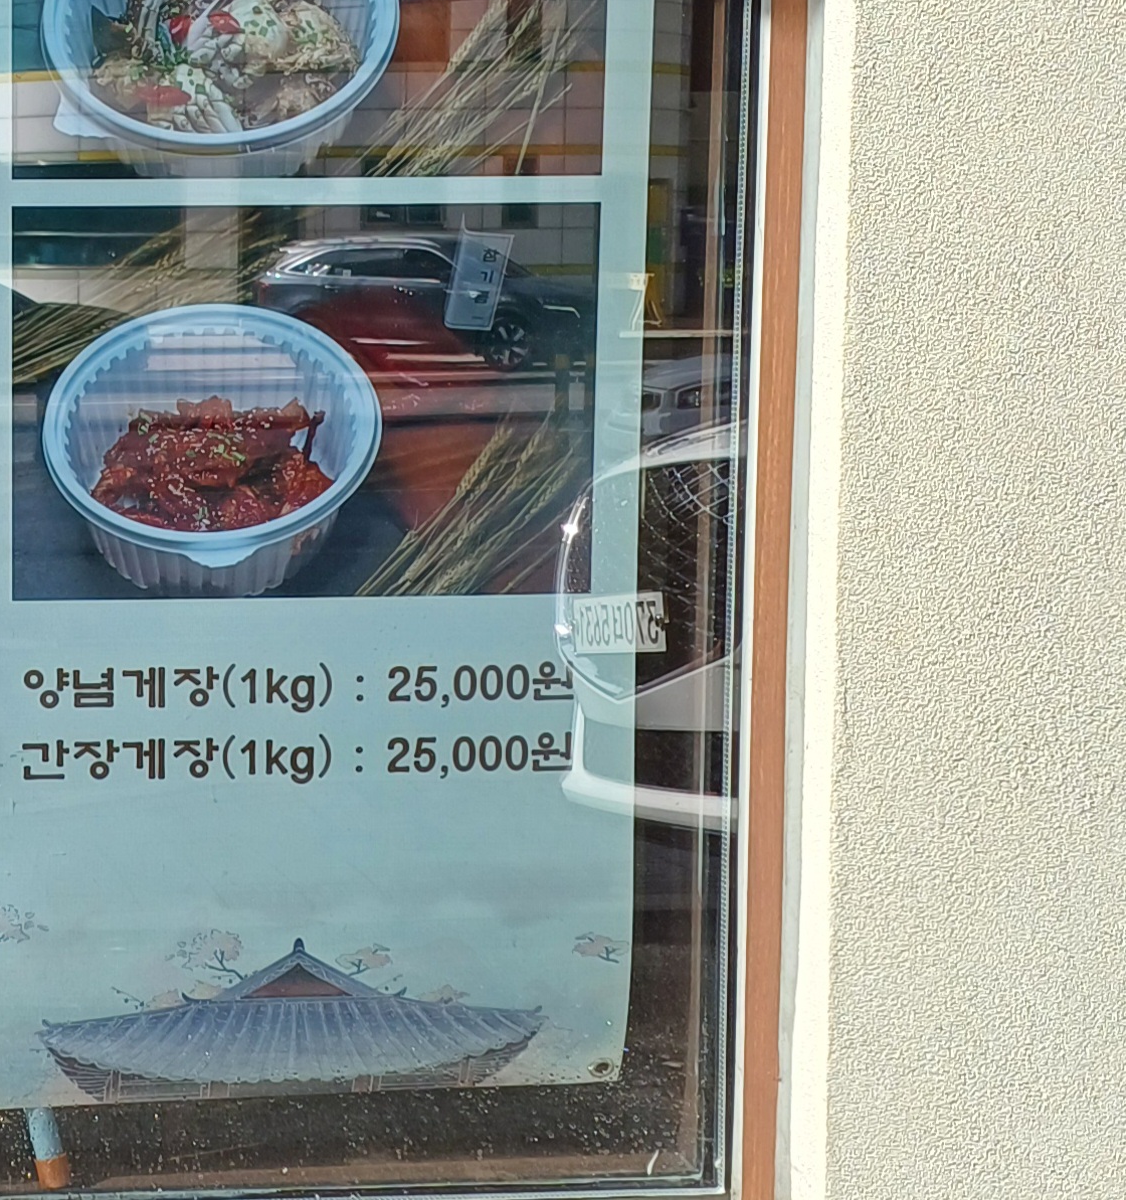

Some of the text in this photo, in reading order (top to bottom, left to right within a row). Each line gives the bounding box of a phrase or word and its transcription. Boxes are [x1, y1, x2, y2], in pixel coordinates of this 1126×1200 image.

[24, 664, 333, 712] 양념게장(1kg)
[388, 661, 574, 709] 25,000원
[22, 735, 333, 784] 간장게장(1kg)
[386, 732, 573, 780] 25,000원
